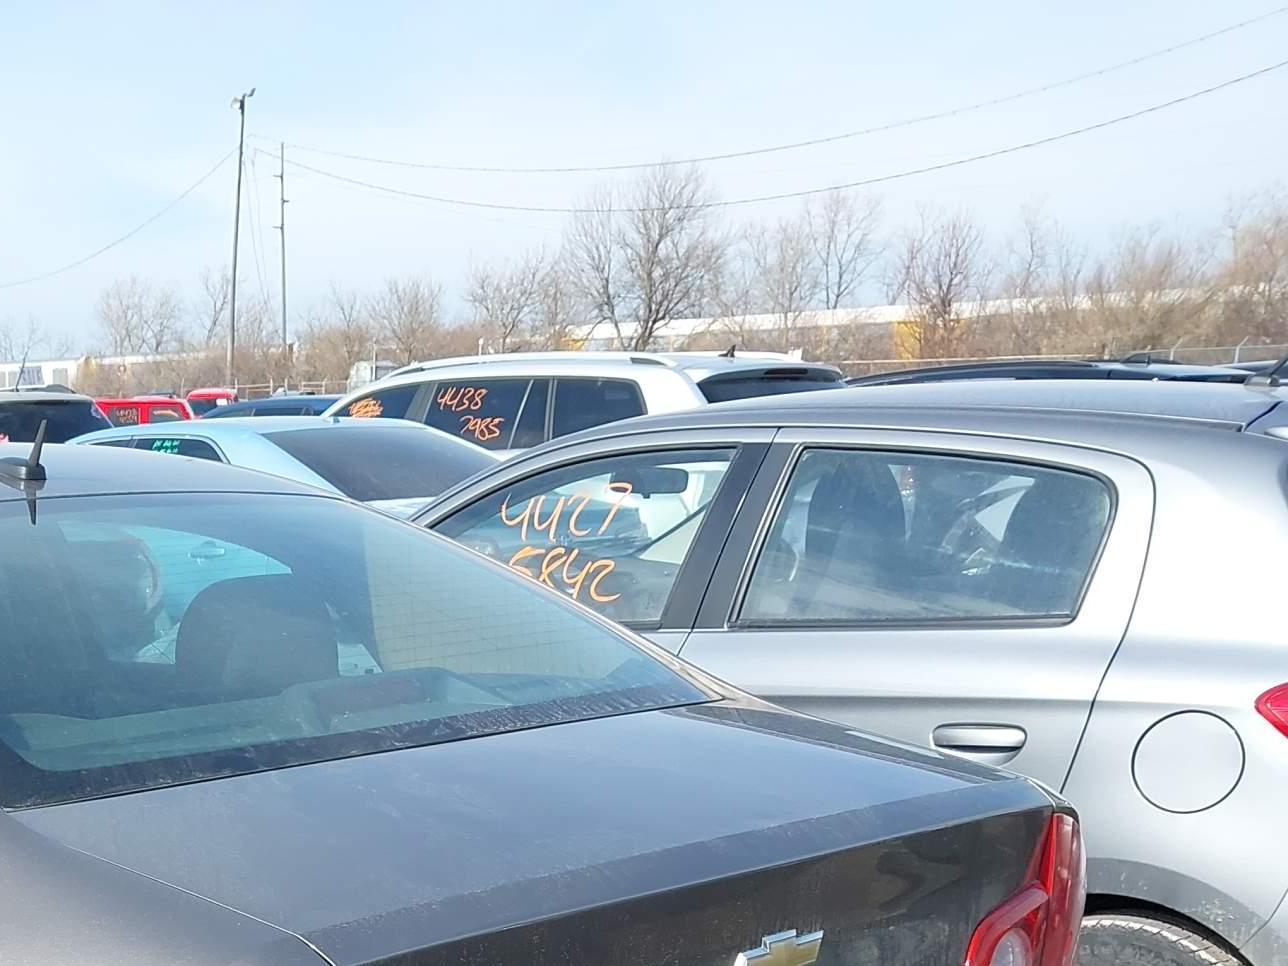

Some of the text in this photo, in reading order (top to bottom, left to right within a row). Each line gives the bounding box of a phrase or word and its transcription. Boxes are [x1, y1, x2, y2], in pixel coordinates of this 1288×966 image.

[437, 386, 488, 412] 4438
[459, 415, 505, 441] 7985
[500, 481, 633, 543] 4427
